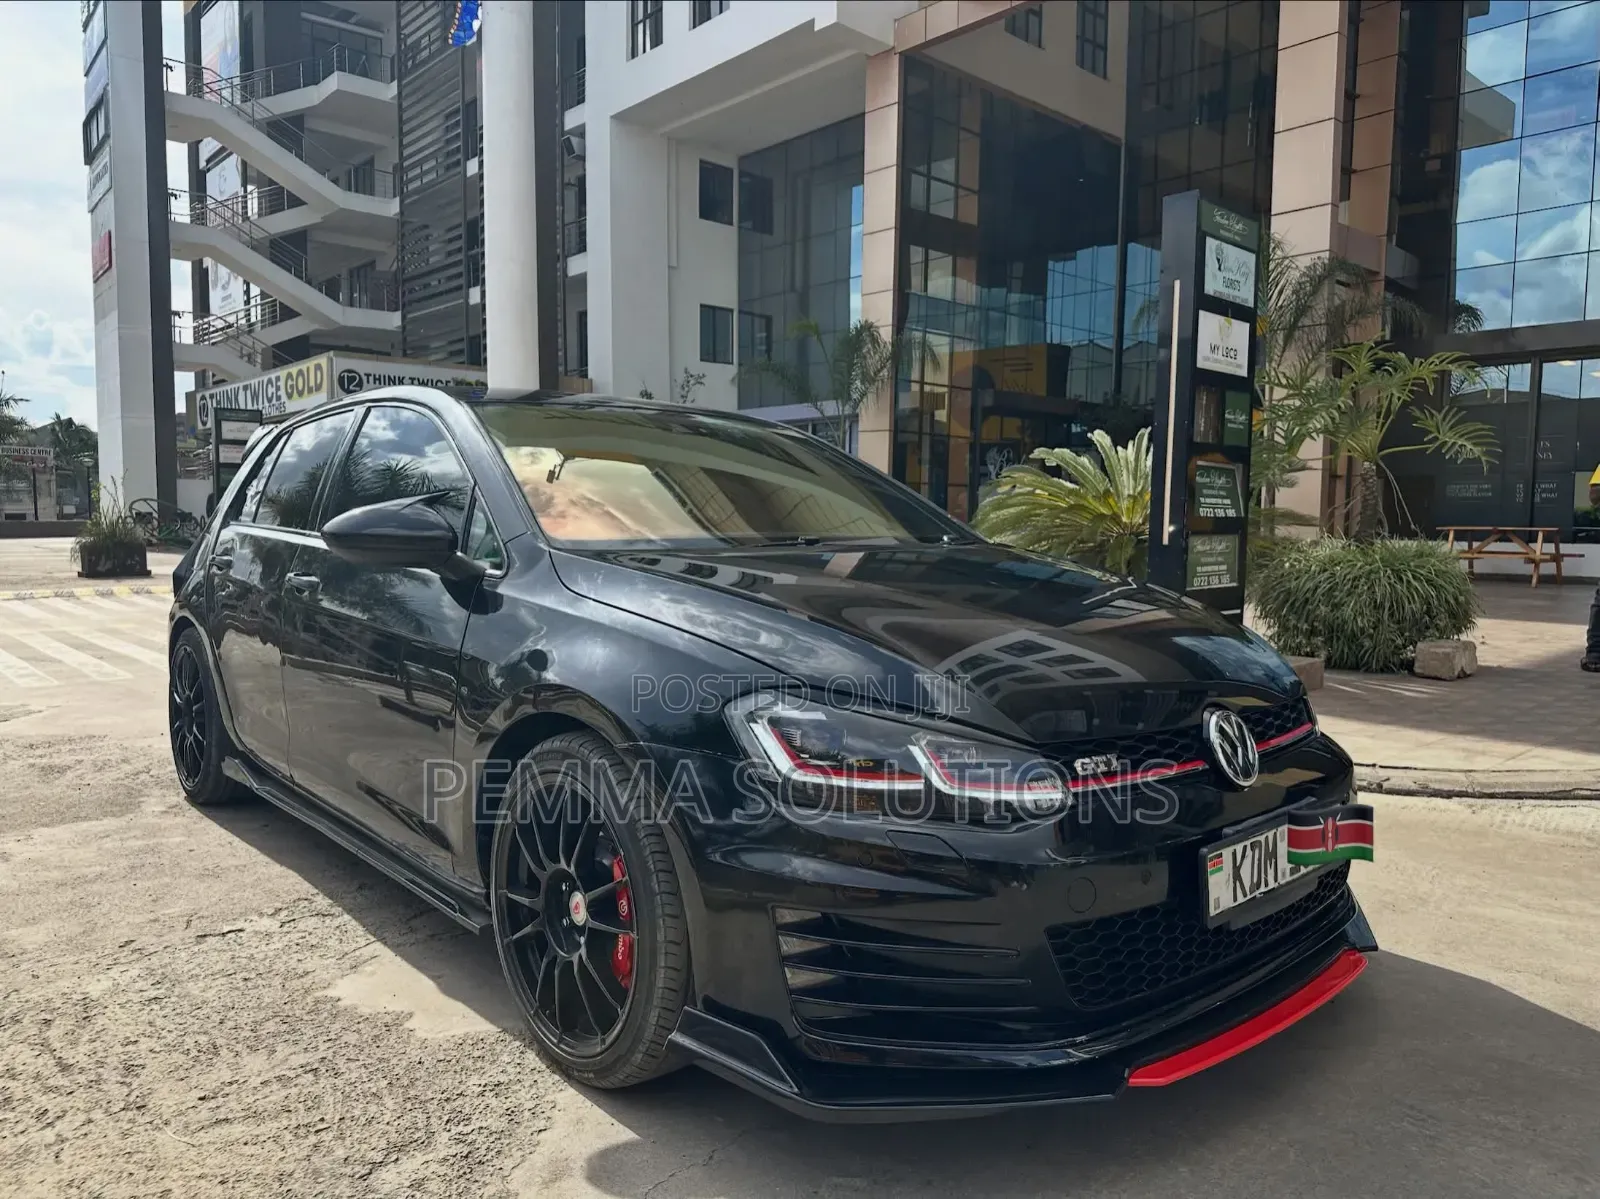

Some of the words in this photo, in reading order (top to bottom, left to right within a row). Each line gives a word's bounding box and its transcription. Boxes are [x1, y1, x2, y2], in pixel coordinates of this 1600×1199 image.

[1210, 342, 1220, 356] MY
[209, 387, 240, 409] THINK
[242, 375, 281, 410] TWICE
[285, 363, 323, 400] GOLD
[364, 373, 406, 387] THINK
[1074, 753, 1121, 776] GTI
[1231, 831, 1279, 904] KDM
